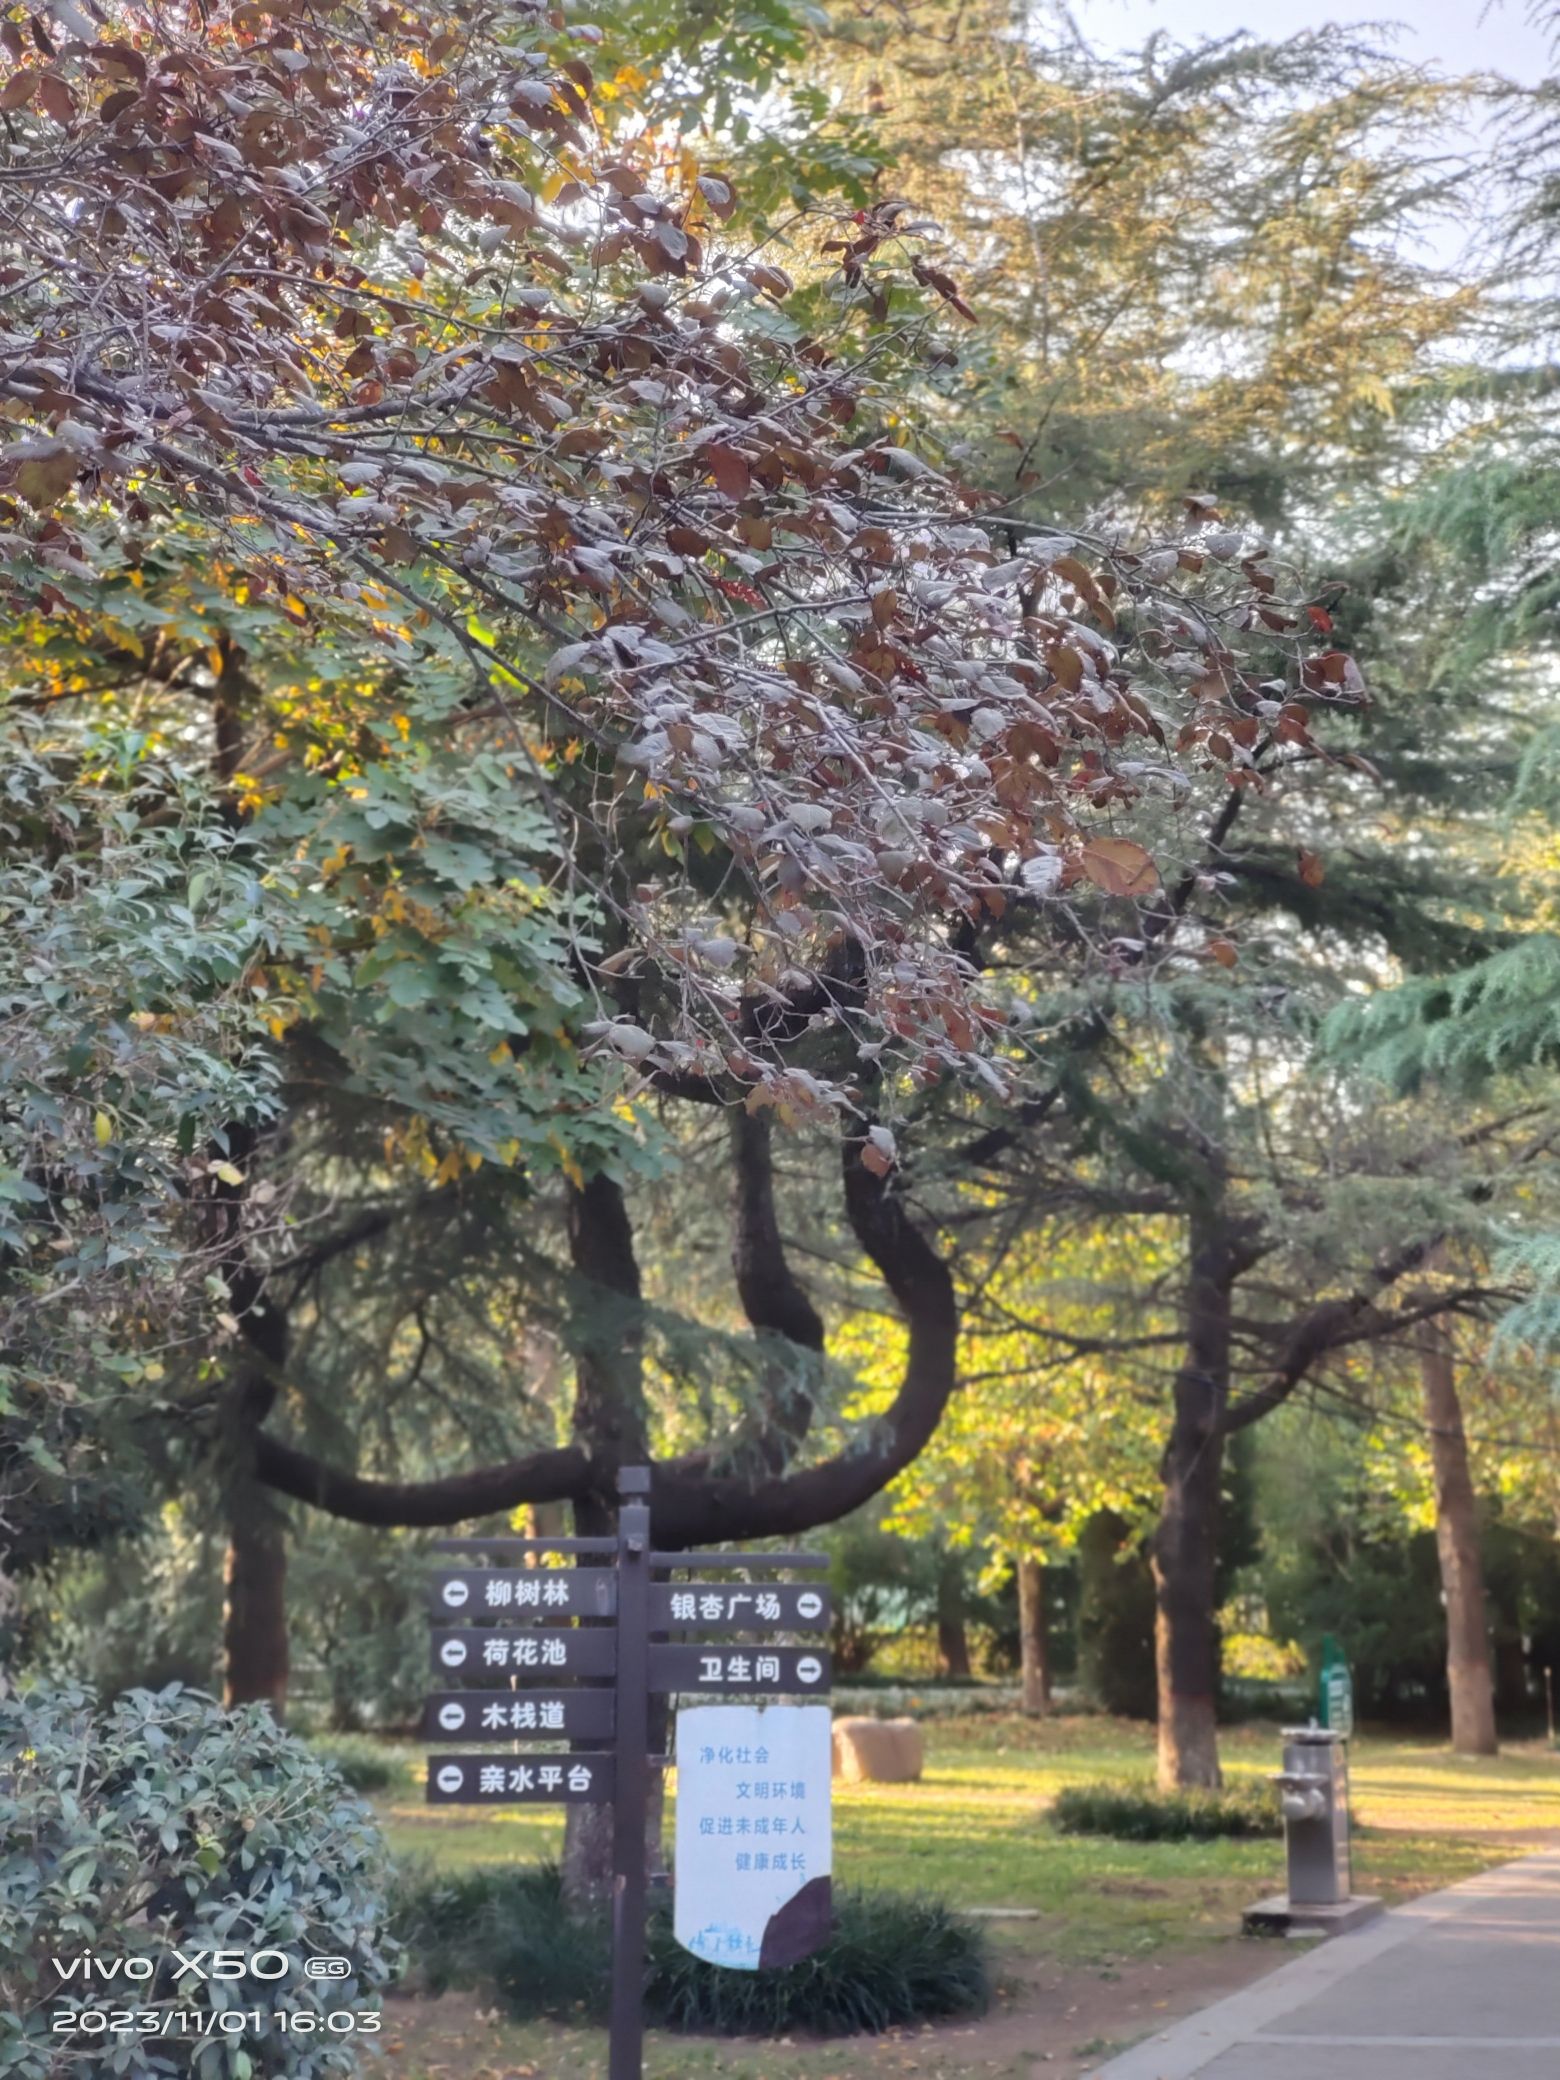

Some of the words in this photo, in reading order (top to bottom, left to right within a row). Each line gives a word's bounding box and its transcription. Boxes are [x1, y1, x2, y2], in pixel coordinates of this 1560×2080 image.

[485, 1579, 569, 1607] 柳树林
[670, 1593, 780, 1621] 银杏广场
[482, 1638, 567, 1665] 荷花池
[699, 1656, 780, 1682] 卫生间
[481, 1702, 565, 1730] 木栈道
[700, 1746, 769, 1764] 净化社会
[479, 1765, 592, 1793] 亲水平台
[736, 1781, 806, 1800] 文明环境
[699, 1817, 806, 1835] 促进未成年人
[735, 1853, 806, 1871] 健康成长
